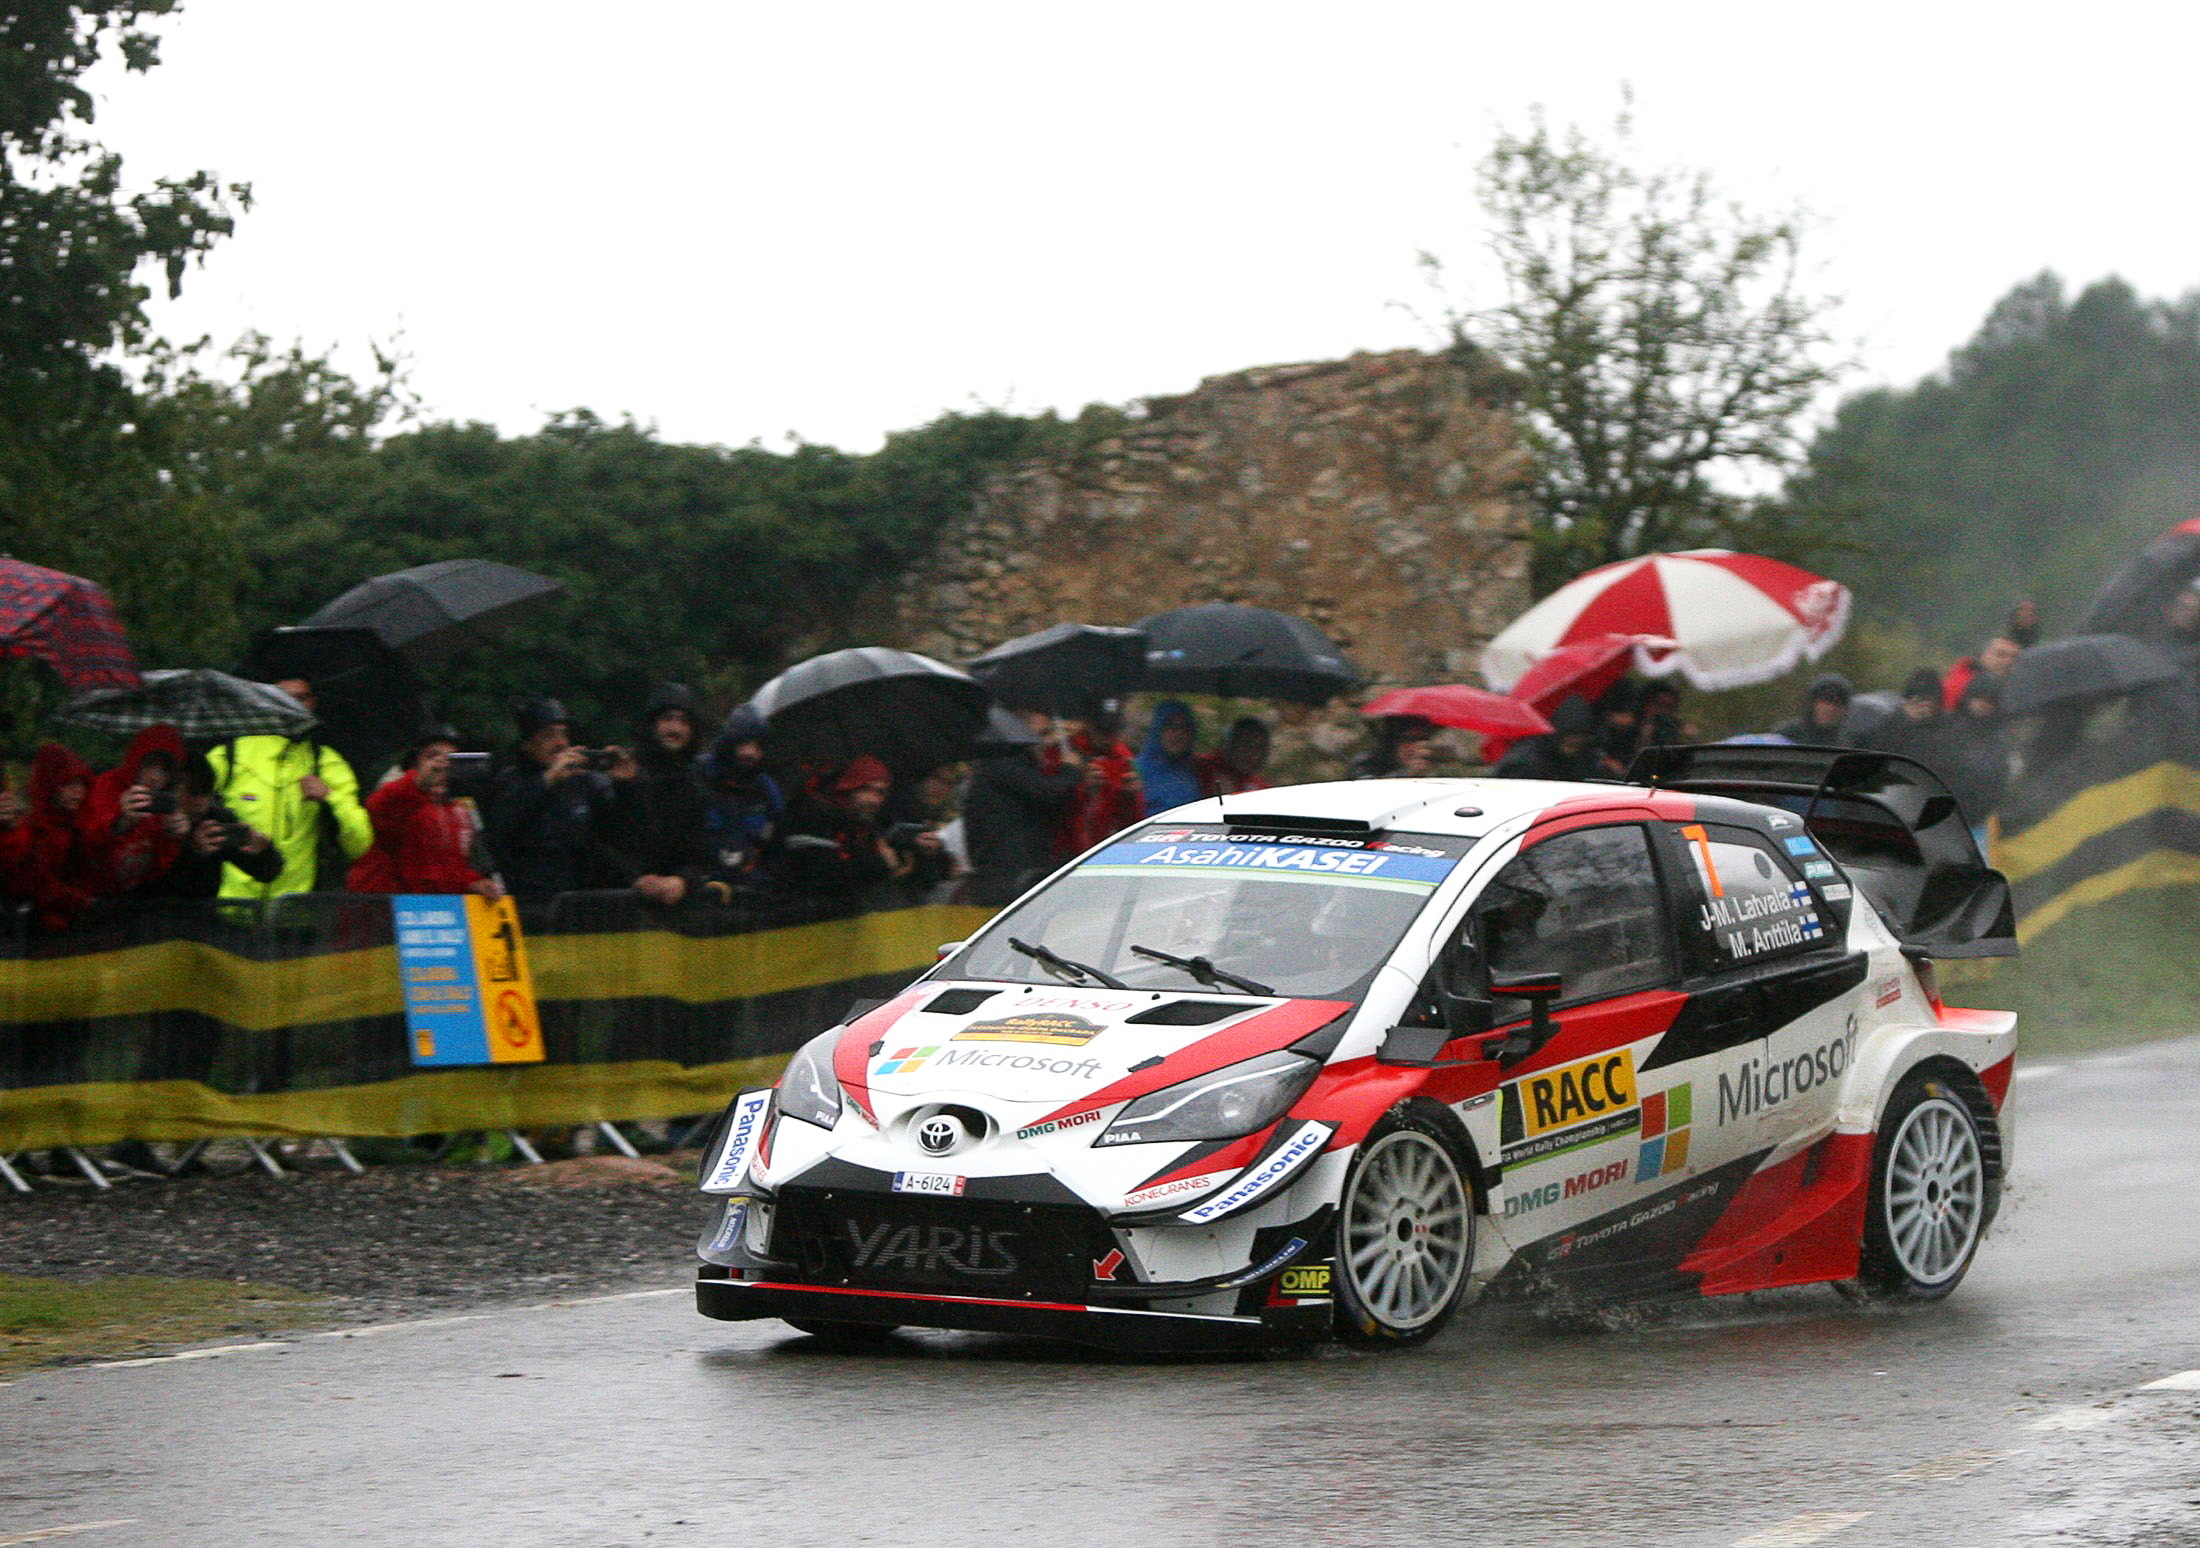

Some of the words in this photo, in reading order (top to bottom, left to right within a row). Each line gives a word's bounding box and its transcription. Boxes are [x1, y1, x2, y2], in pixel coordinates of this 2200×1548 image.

[1190, 834, 1277, 843] TOYOTA
[1279, 835, 1365, 848] GAZOO
[1366, 842, 1446, 858] Racing
[1680, 824, 1725, 896] 7
[1732, 887, 1793, 921] Latvala
[1728, 931, 1752, 959] M.
[1753, 920, 1803, 954] Anttila
[935, 1048, 1102, 1079] Microsoft
[1532, 1056, 1628, 1128] RACC
[1016, 1122, 1056, 1140] DMG
[1057, 1110, 1102, 1130] MORI
[1104, 1131, 1142, 1144] PIAA
[713, 1098, 765, 1186] Panasonic
[906, 1175, 951, 1191] A-6124
[1194, 1132, 1319, 1218] Panasonic
[1503, 1182, 1561, 1220] DMG
[1563, 1158, 1629, 1201] MORI
[1123, 1177, 1211, 1207] KONECRANES
[1576, 1219, 1628, 1249] TOYOTA
[1281, 1270, 1331, 1289] OMP
